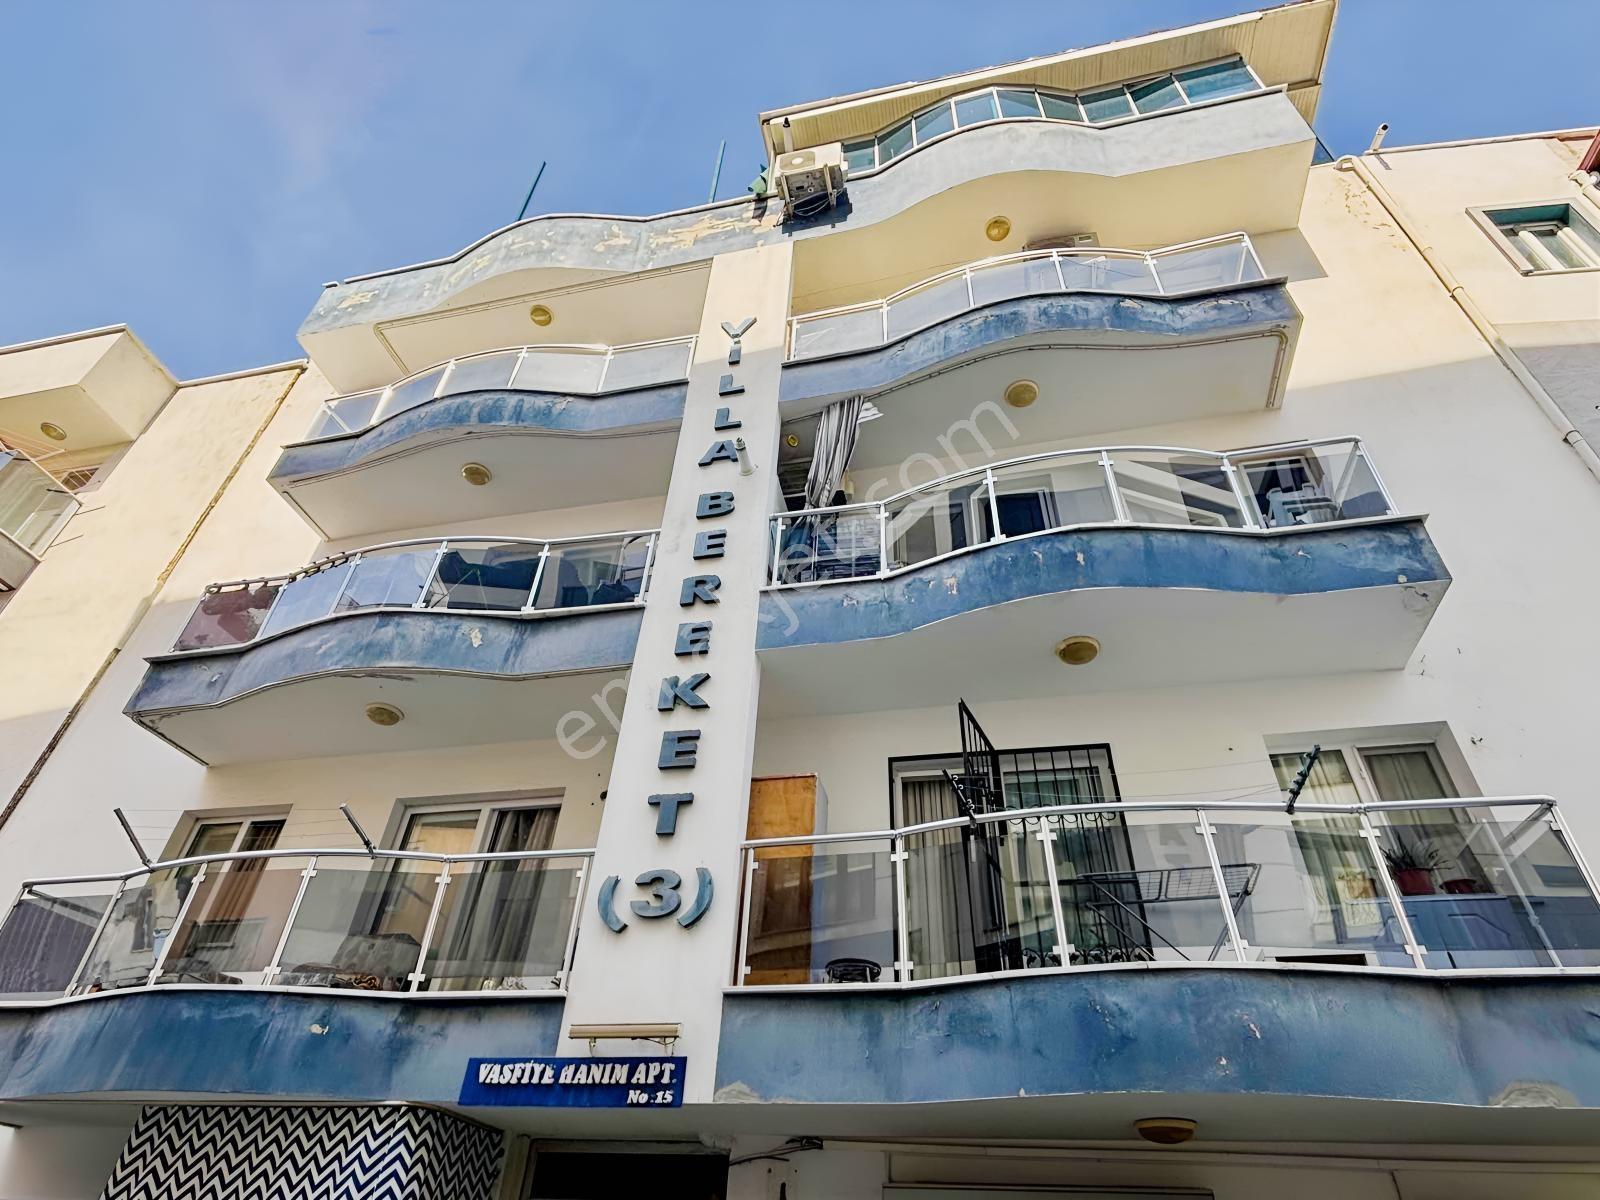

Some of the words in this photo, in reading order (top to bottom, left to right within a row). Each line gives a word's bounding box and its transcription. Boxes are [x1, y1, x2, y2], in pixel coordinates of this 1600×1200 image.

[647, 490, 735, 836] BEREKET
[597, 867, 714, 934] (3)
[558, 1063, 630, 1084] HANIM
[630, 1062, 677, 1084] APT.
